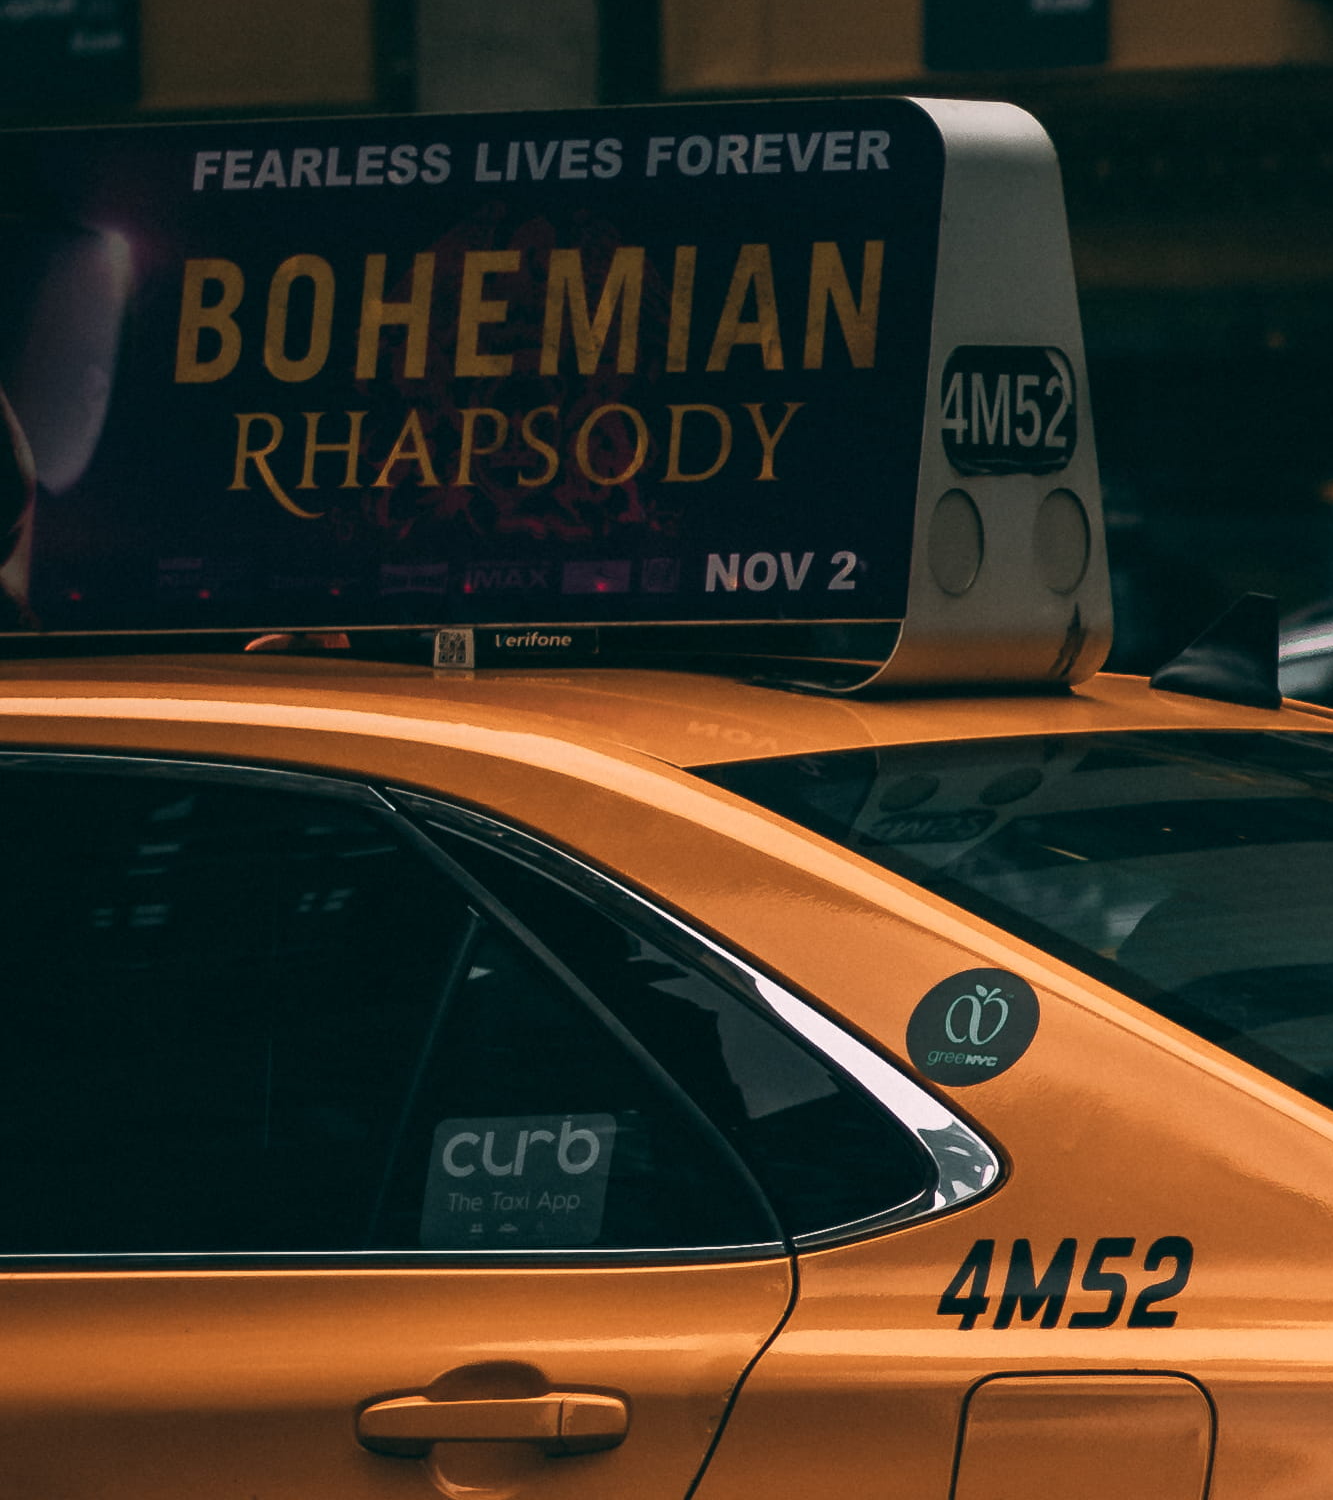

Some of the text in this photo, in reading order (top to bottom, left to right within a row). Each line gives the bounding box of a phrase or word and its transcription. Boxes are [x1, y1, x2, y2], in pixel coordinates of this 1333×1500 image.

[192, 130, 891, 192] FEARLESS LIVES FOREVER
[173, 240, 886, 385] BOHEMIAN
[941, 371, 1070, 449] 4M52
[227, 402, 807, 521] RHAPSODY
[704, 549, 858, 592] NOV 2
[494, 631, 573, 649] Verifone
[442, 1120, 601, 1178] curb
[447, 1190, 583, 1214] The Taxi App
[937, 1236, 1194, 1331] 4M52
